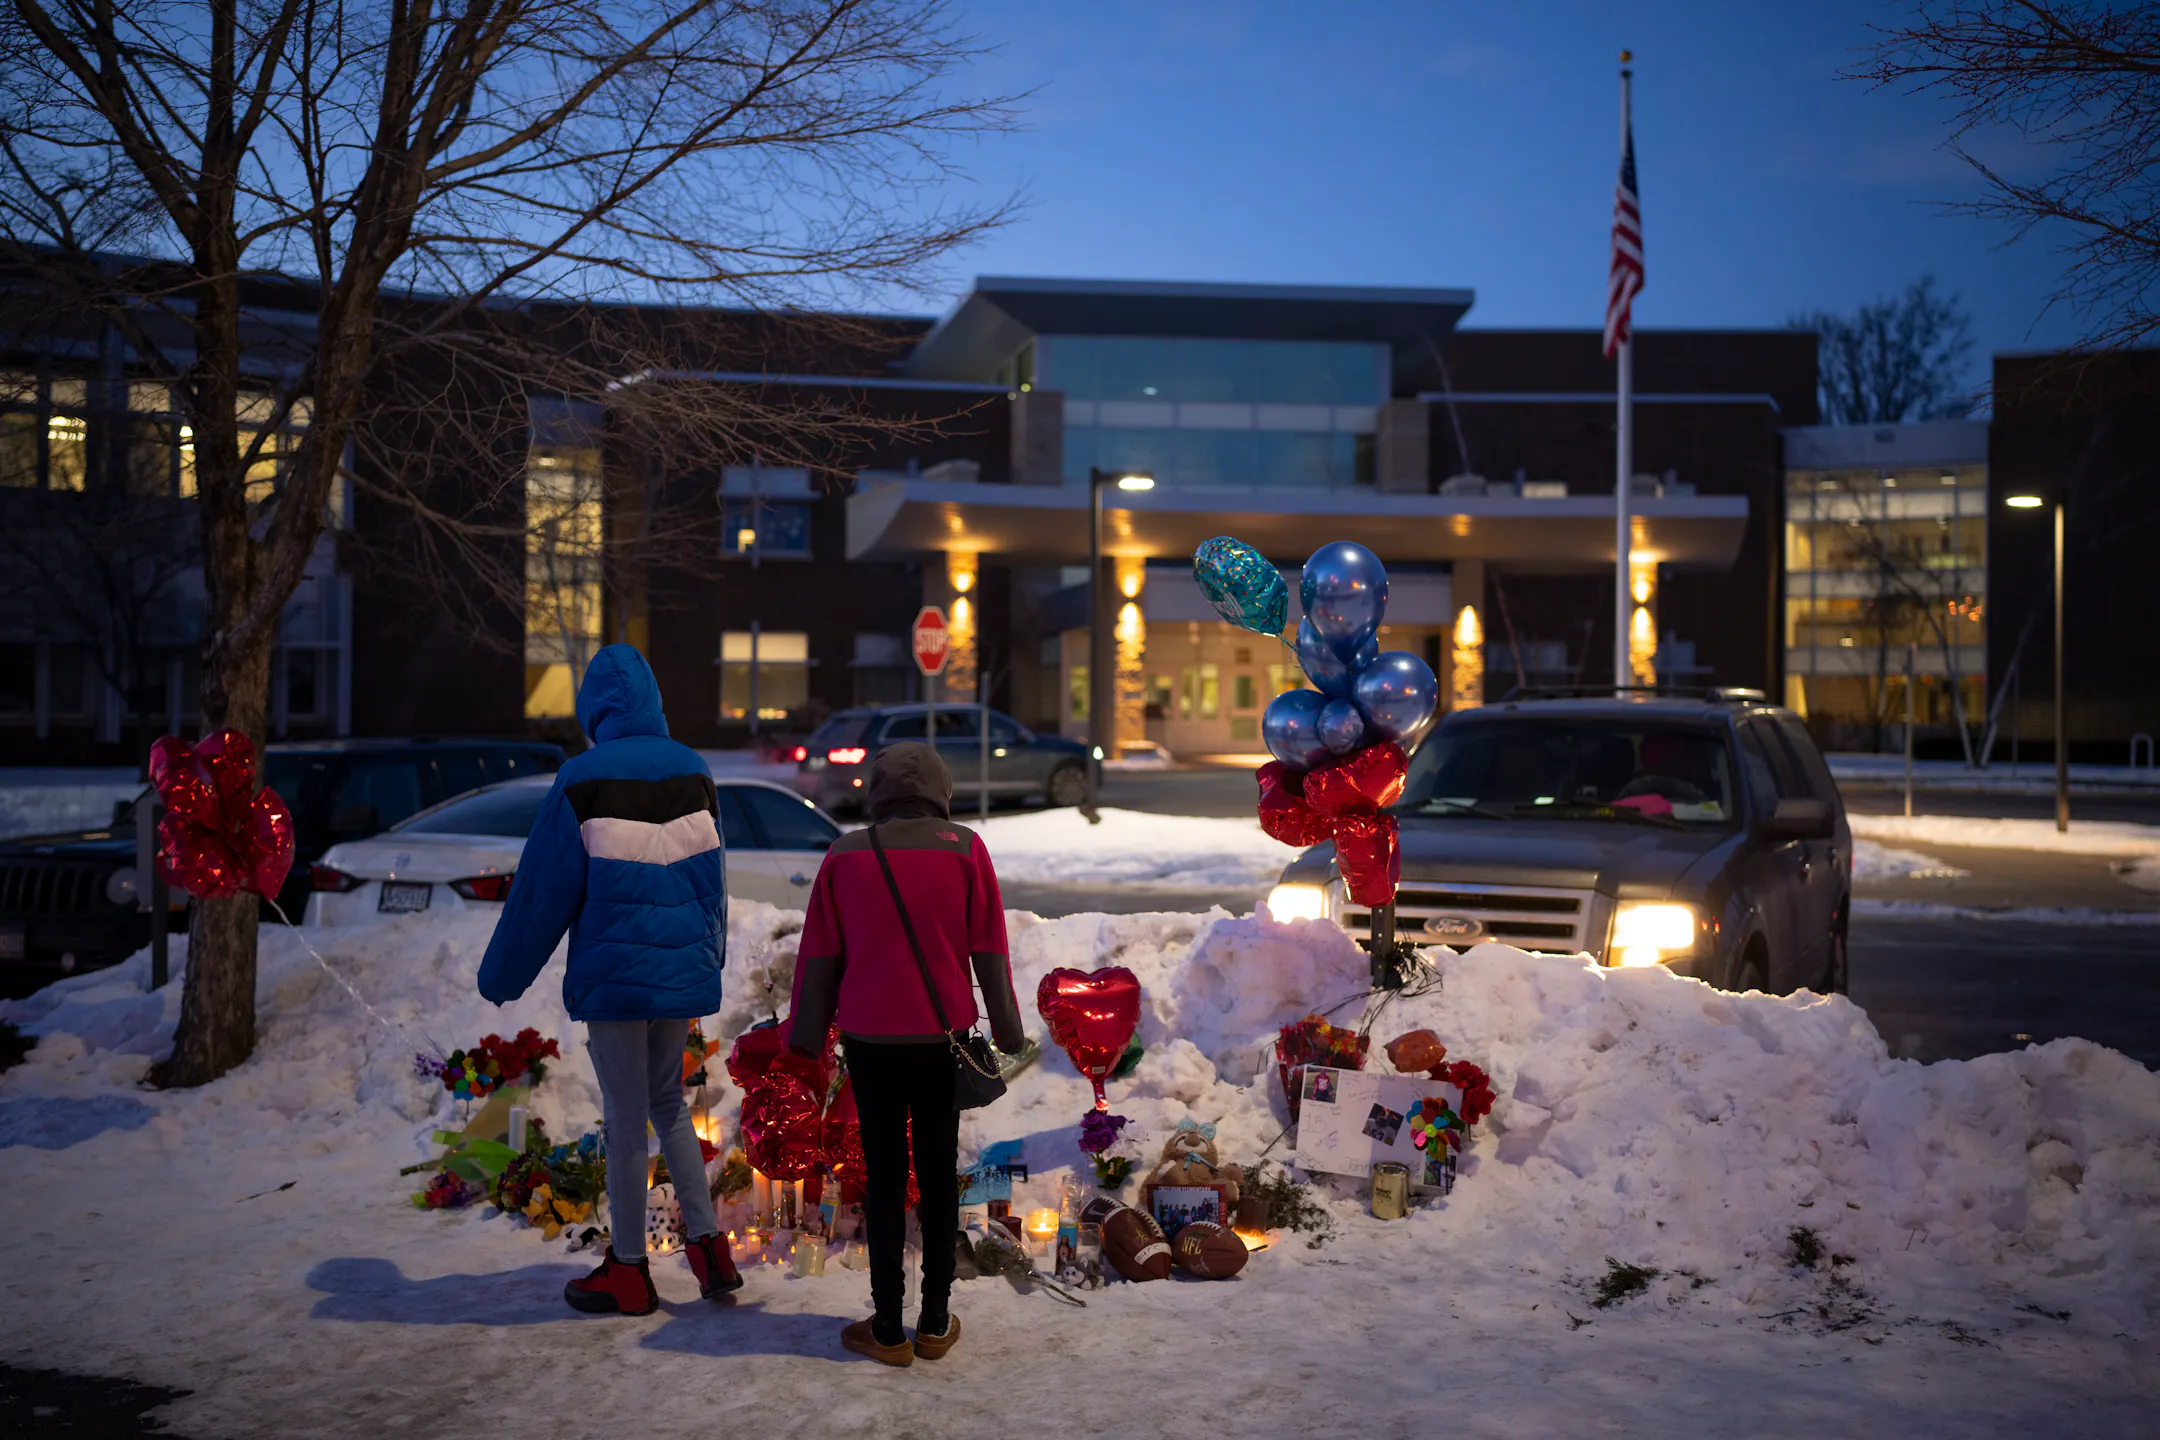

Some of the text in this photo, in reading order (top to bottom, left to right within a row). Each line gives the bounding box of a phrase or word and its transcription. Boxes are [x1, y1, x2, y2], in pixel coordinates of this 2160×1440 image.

[916, 628, 947, 653] STOP
[1435, 919, 1468, 934] Ford
[1301, 1112, 1327, 1134] 15
[1181, 1236, 1202, 1256] NFL
